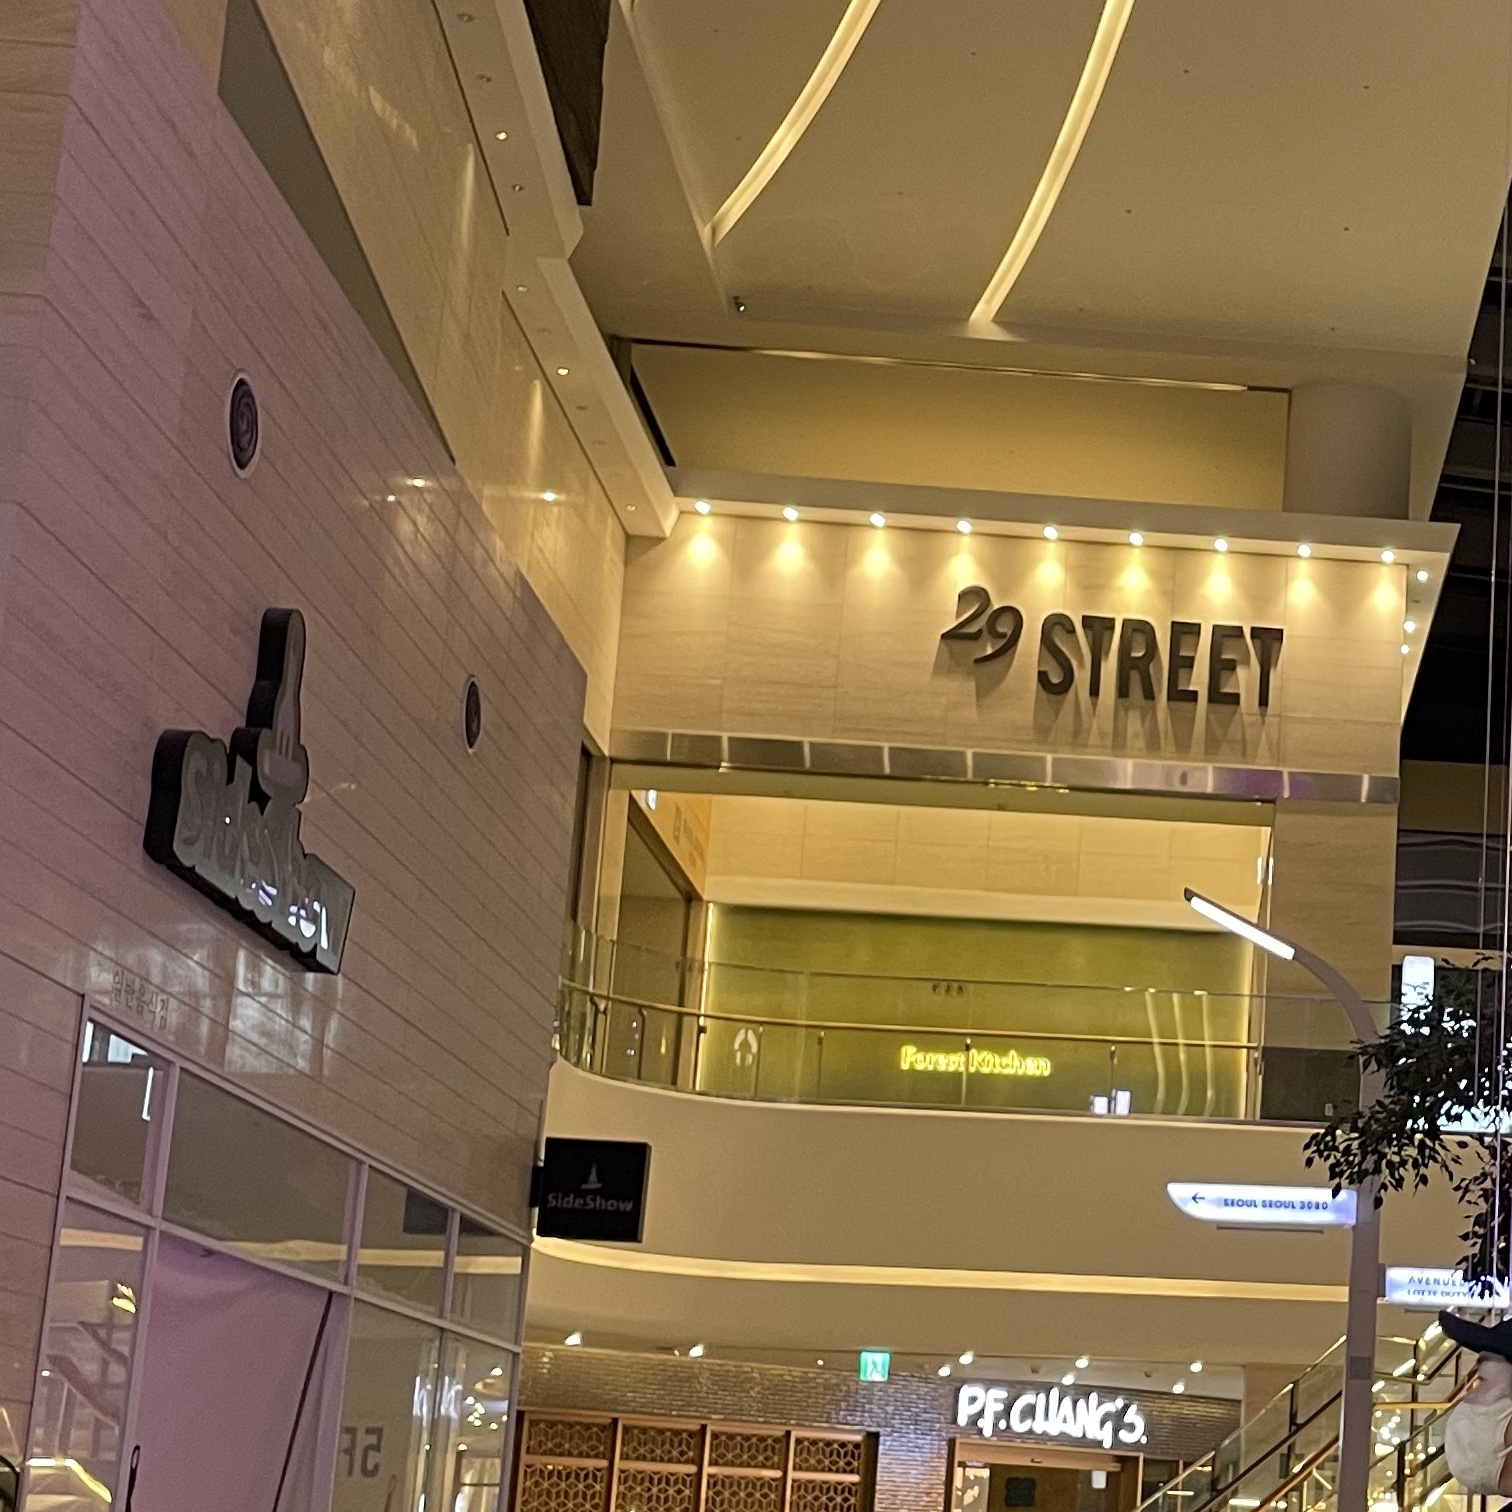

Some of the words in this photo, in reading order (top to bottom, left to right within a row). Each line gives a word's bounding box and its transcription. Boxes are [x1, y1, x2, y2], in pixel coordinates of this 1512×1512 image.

[940, 585, 1024, 665] 29
[1037, 613, 1284, 708] STREET
[900, 1045, 966, 1073] Forest
[969, 1049, 1052, 1078] Kitchen
[546, 1191, 634, 1213] SideShow
[1224, 1198, 1257, 1209] SEOUL
[1262, 1199, 1296, 1210] SEOUL
